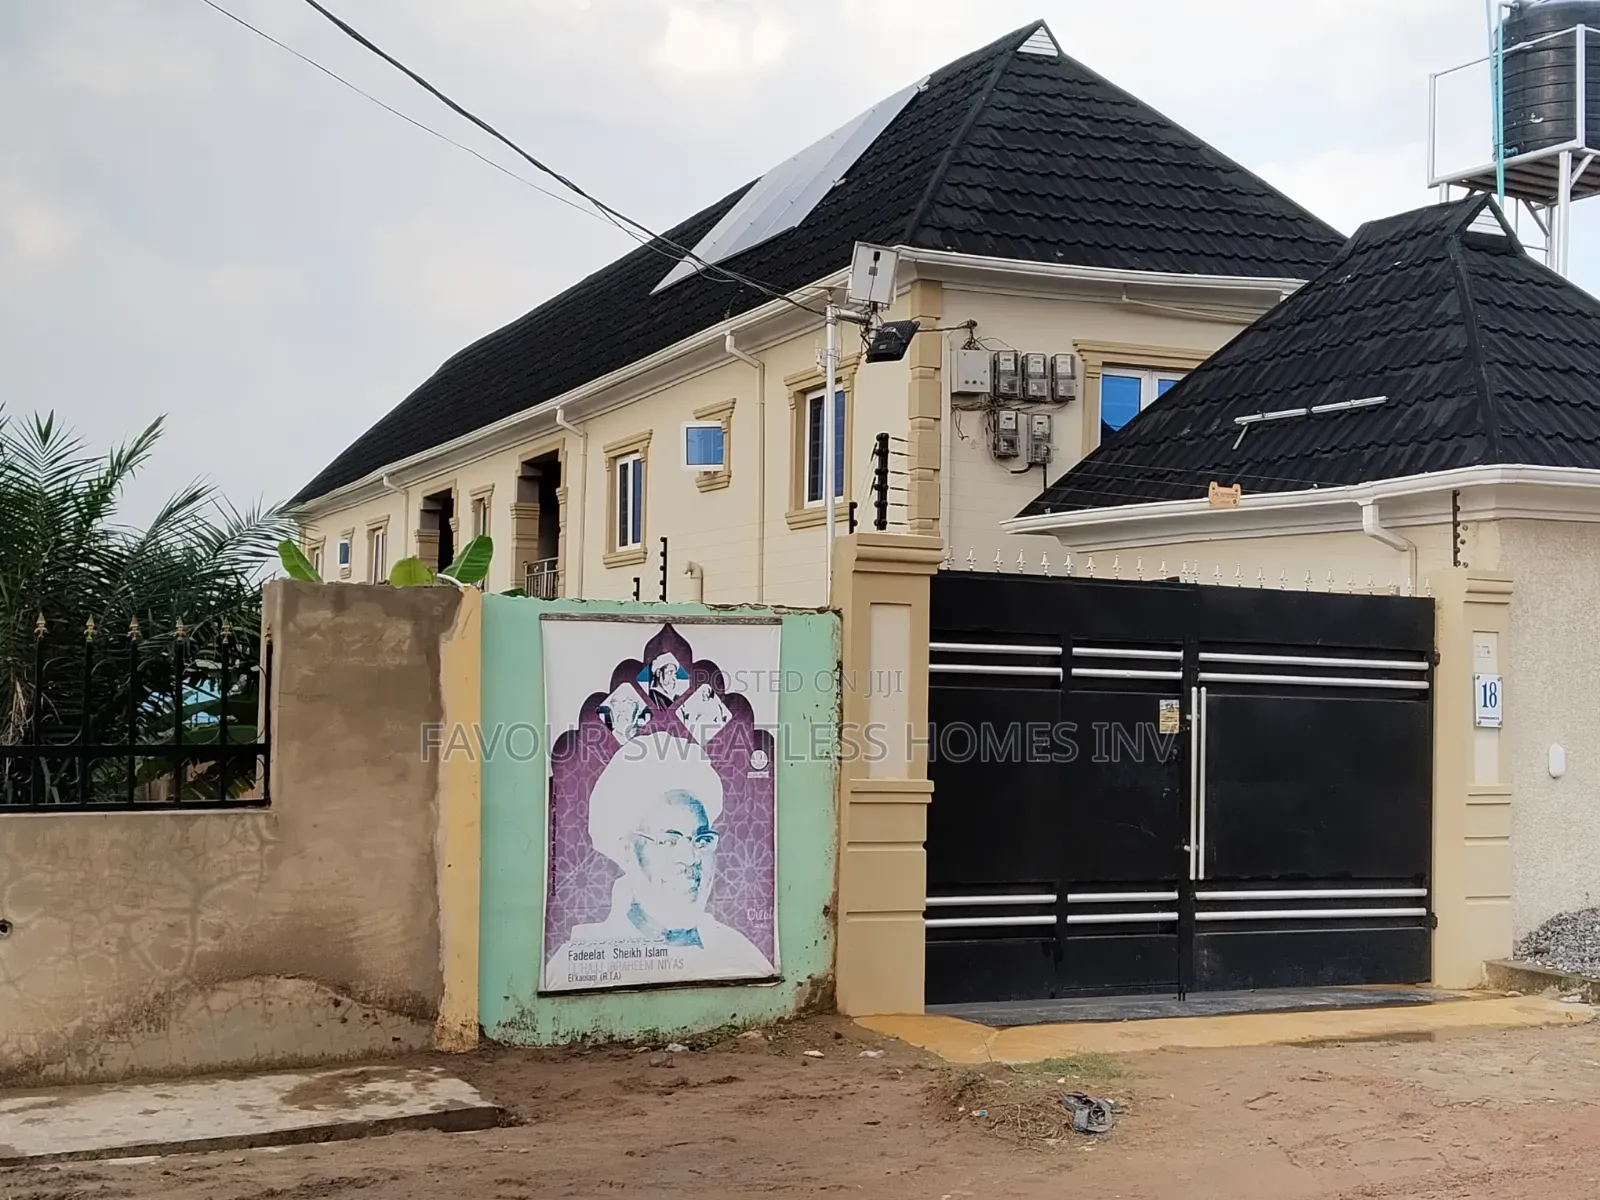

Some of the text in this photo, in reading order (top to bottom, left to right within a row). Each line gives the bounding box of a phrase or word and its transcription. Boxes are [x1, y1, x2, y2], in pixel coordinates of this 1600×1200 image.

[1481, 681, 1498, 708] 18
[568, 947, 668, 961] Fadeelat Sheikh Islam
[657, 958, 684, 971] NIYAS
